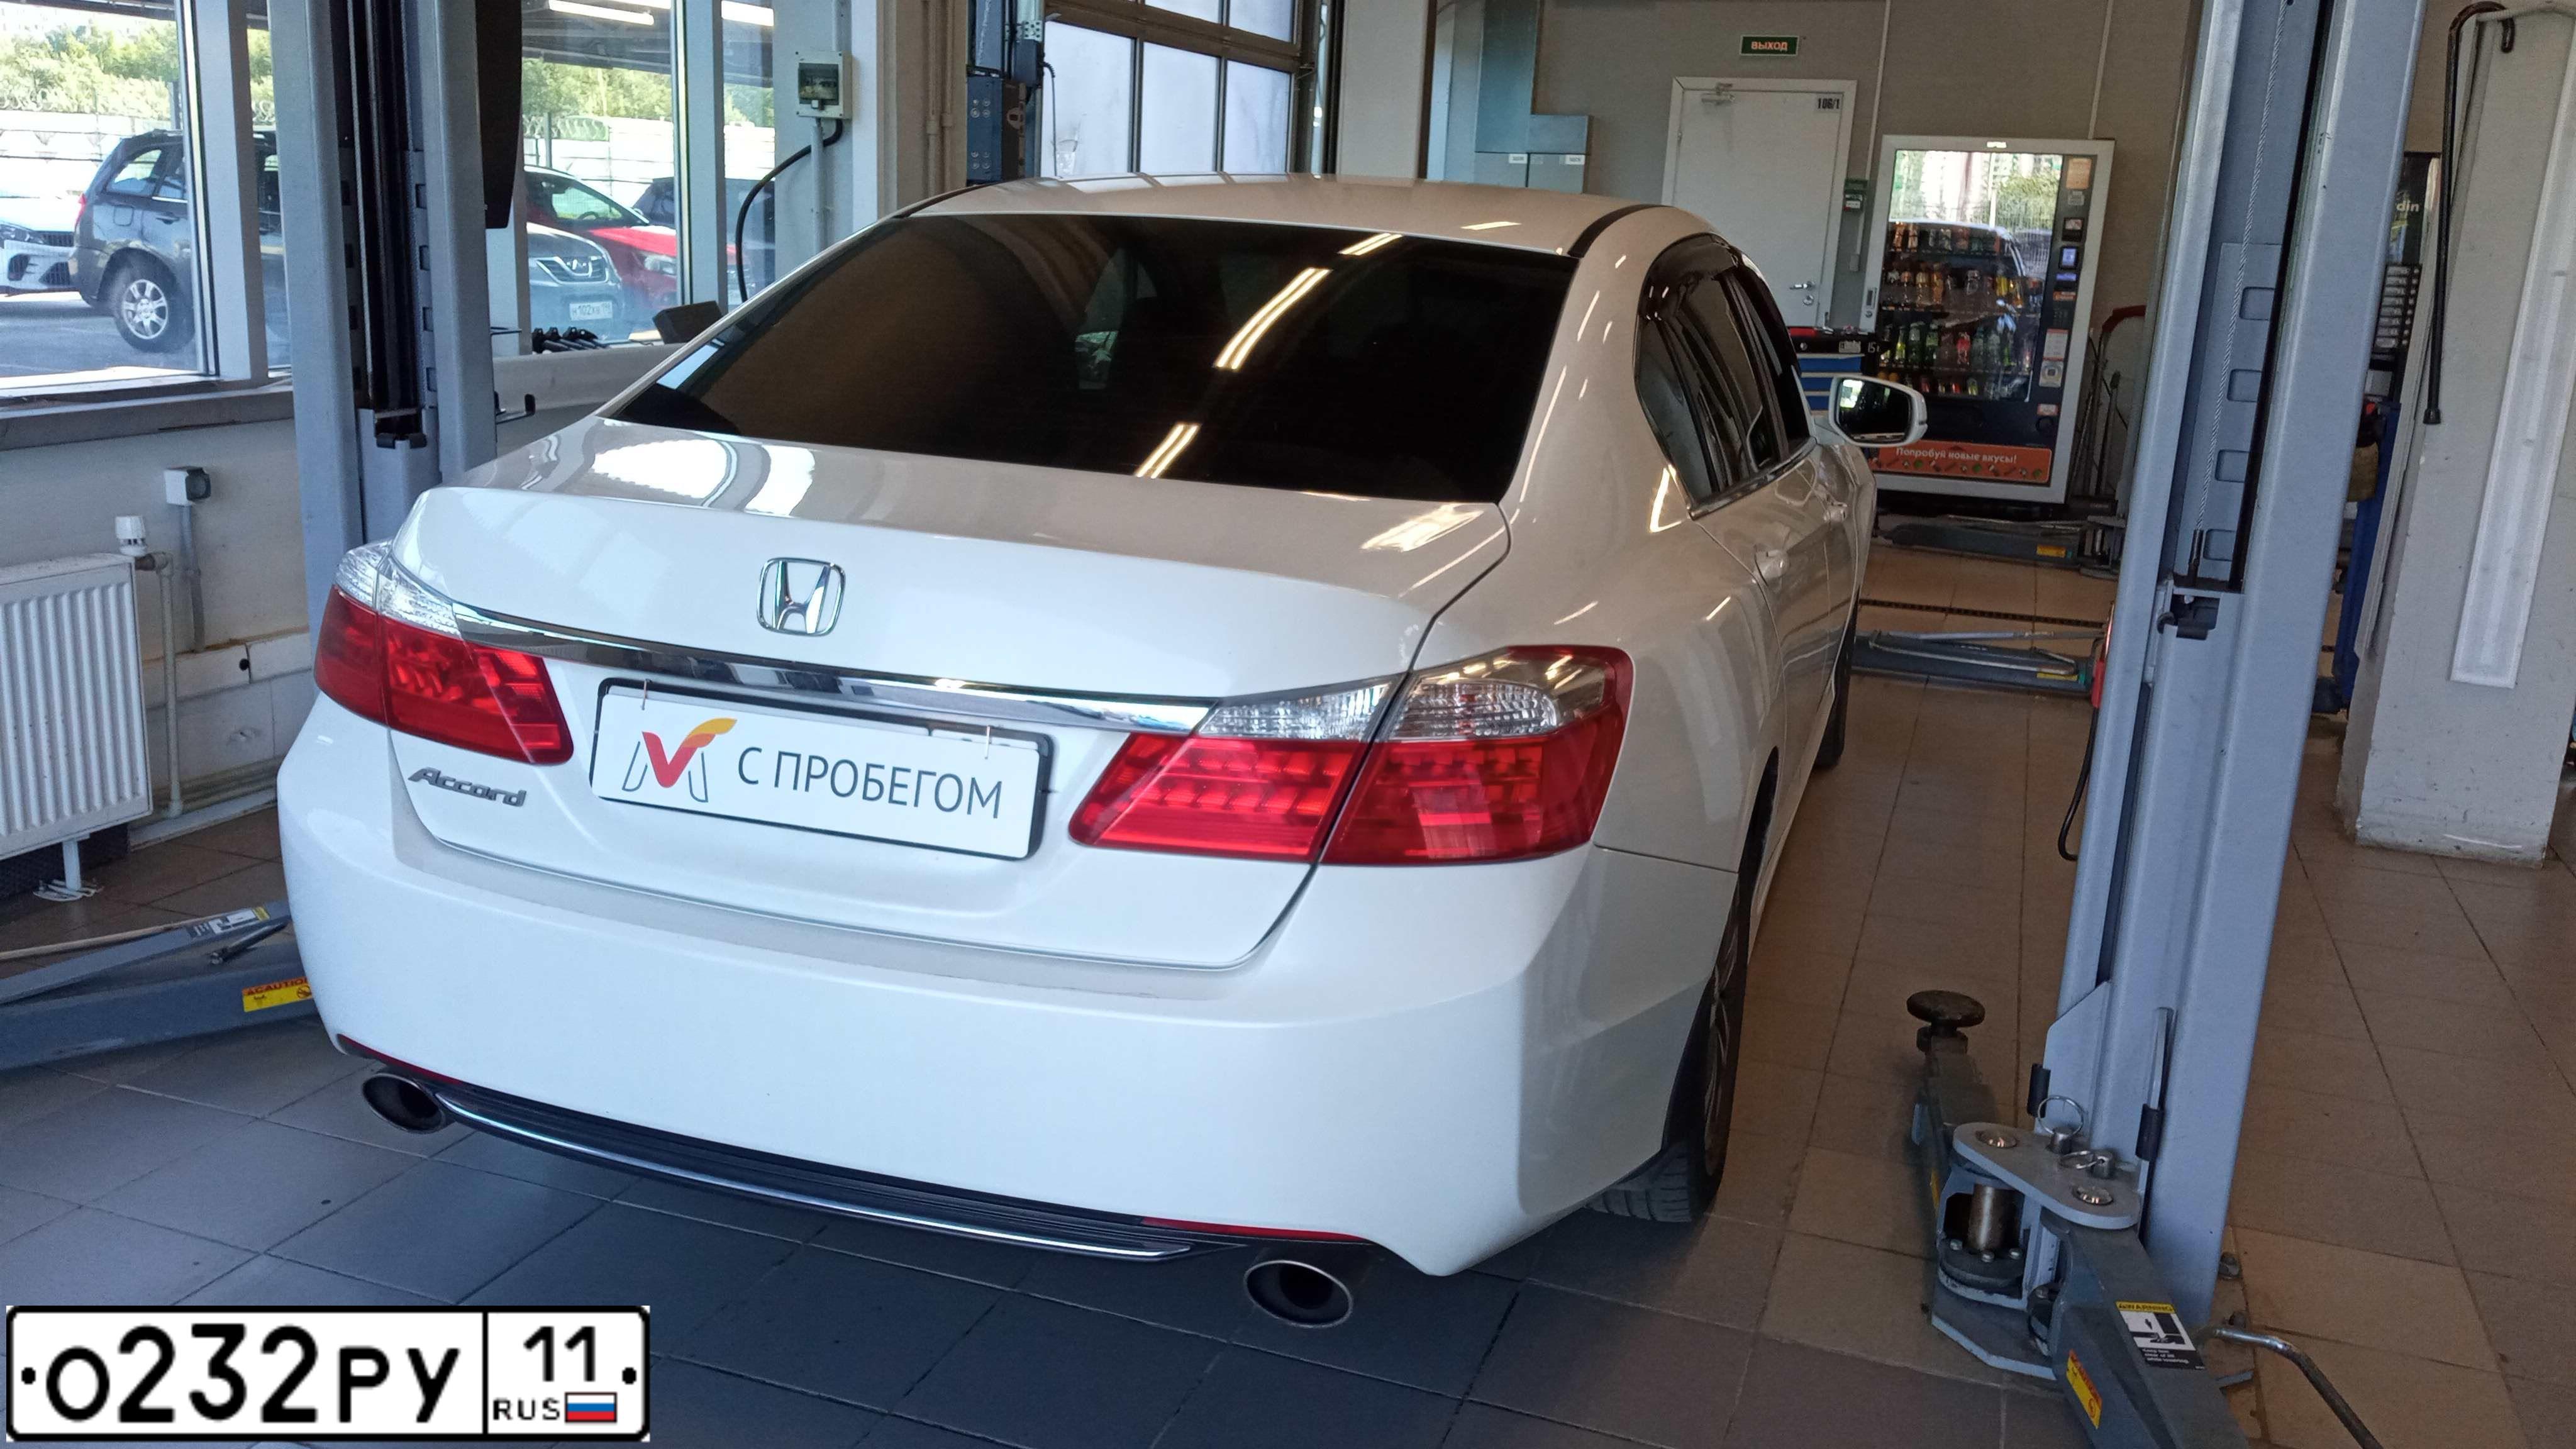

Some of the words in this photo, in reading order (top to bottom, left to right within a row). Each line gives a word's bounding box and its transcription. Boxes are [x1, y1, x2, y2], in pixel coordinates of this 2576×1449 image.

[1751, 42, 1788, 52] ВЫХОД
[1896, 447, 1946, 459] Попробуй
[1948, 452, 1980, 460] новые
[1982, 455, 2017, 464] вкусы!
[408, 767, 527, 808] Accord
[738, 747, 763, 785] С
[774, 751, 1002, 819] ПРОБЕГОМ
